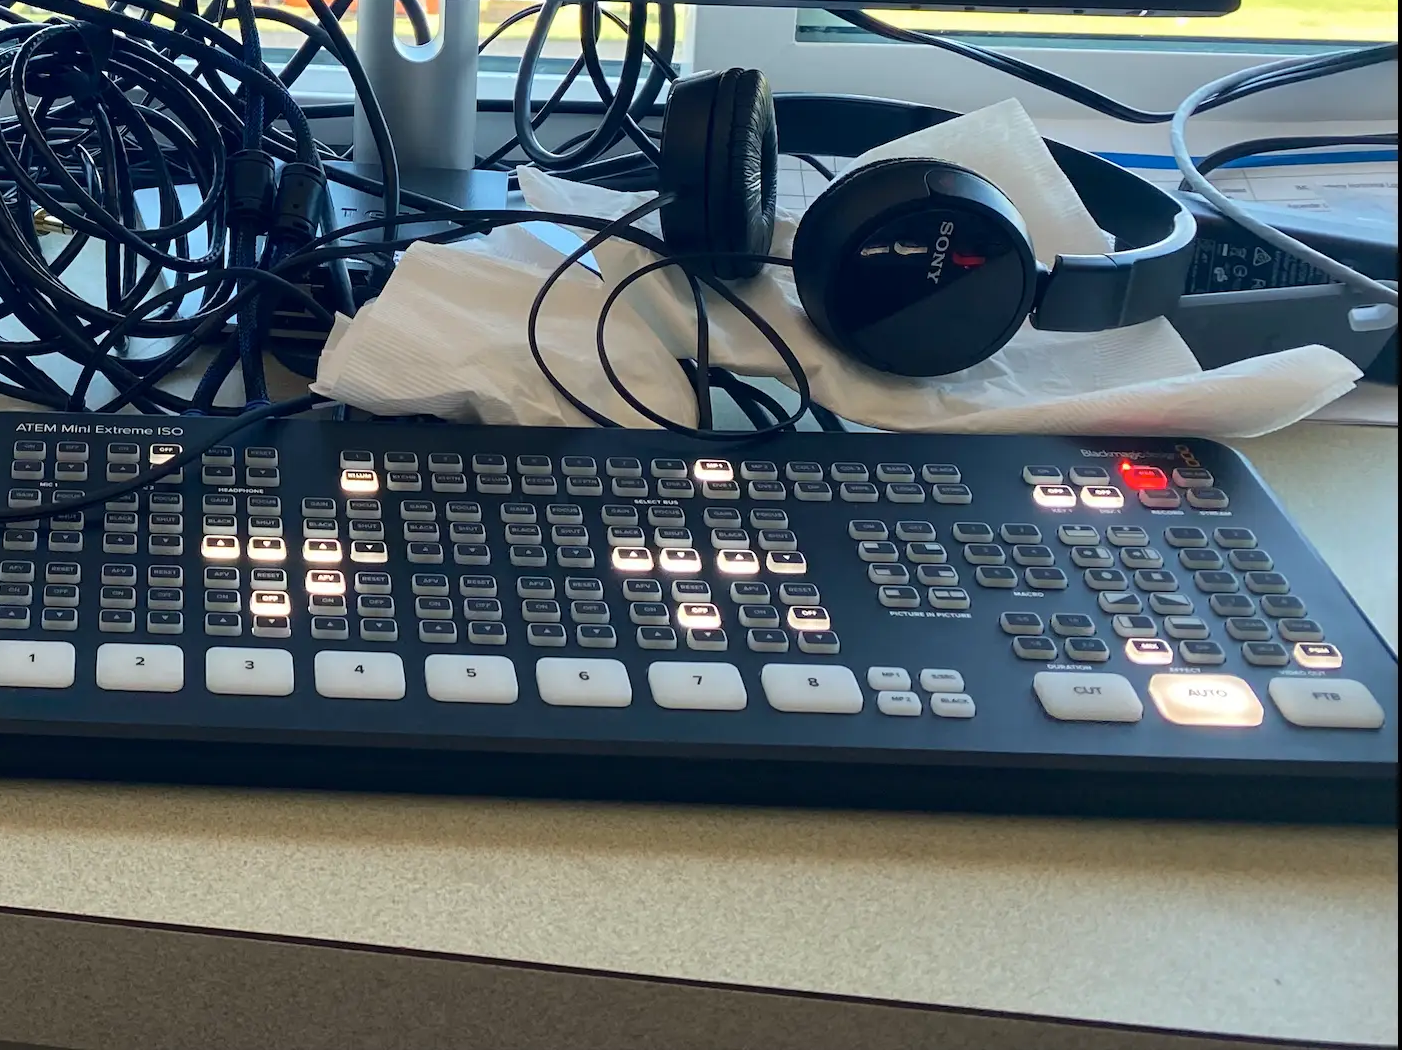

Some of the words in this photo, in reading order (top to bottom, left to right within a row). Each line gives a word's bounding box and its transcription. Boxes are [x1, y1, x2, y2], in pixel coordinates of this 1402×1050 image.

[927, 221, 954, 284] SONY
[16, 423, 57, 433] ATEM
[61, 424, 91, 434] Mini
[95, 425, 153, 436] Extreme
[157, 426, 184, 436] ISO
[28, 653, 35, 663] 1
[135, 656, 145, 666] 2
[245, 660, 254, 670] 3
[354, 664, 365, 674] 4
[466, 668, 476, 678] 5
[579, 671, 590, 681] 6
[692, 676, 702, 686] 7
[808, 678, 819, 687] 8
[1073, 686, 1102, 696] CUT
[1188, 688, 1227, 698] AUTO
[1312, 692, 1340, 701] FTB
